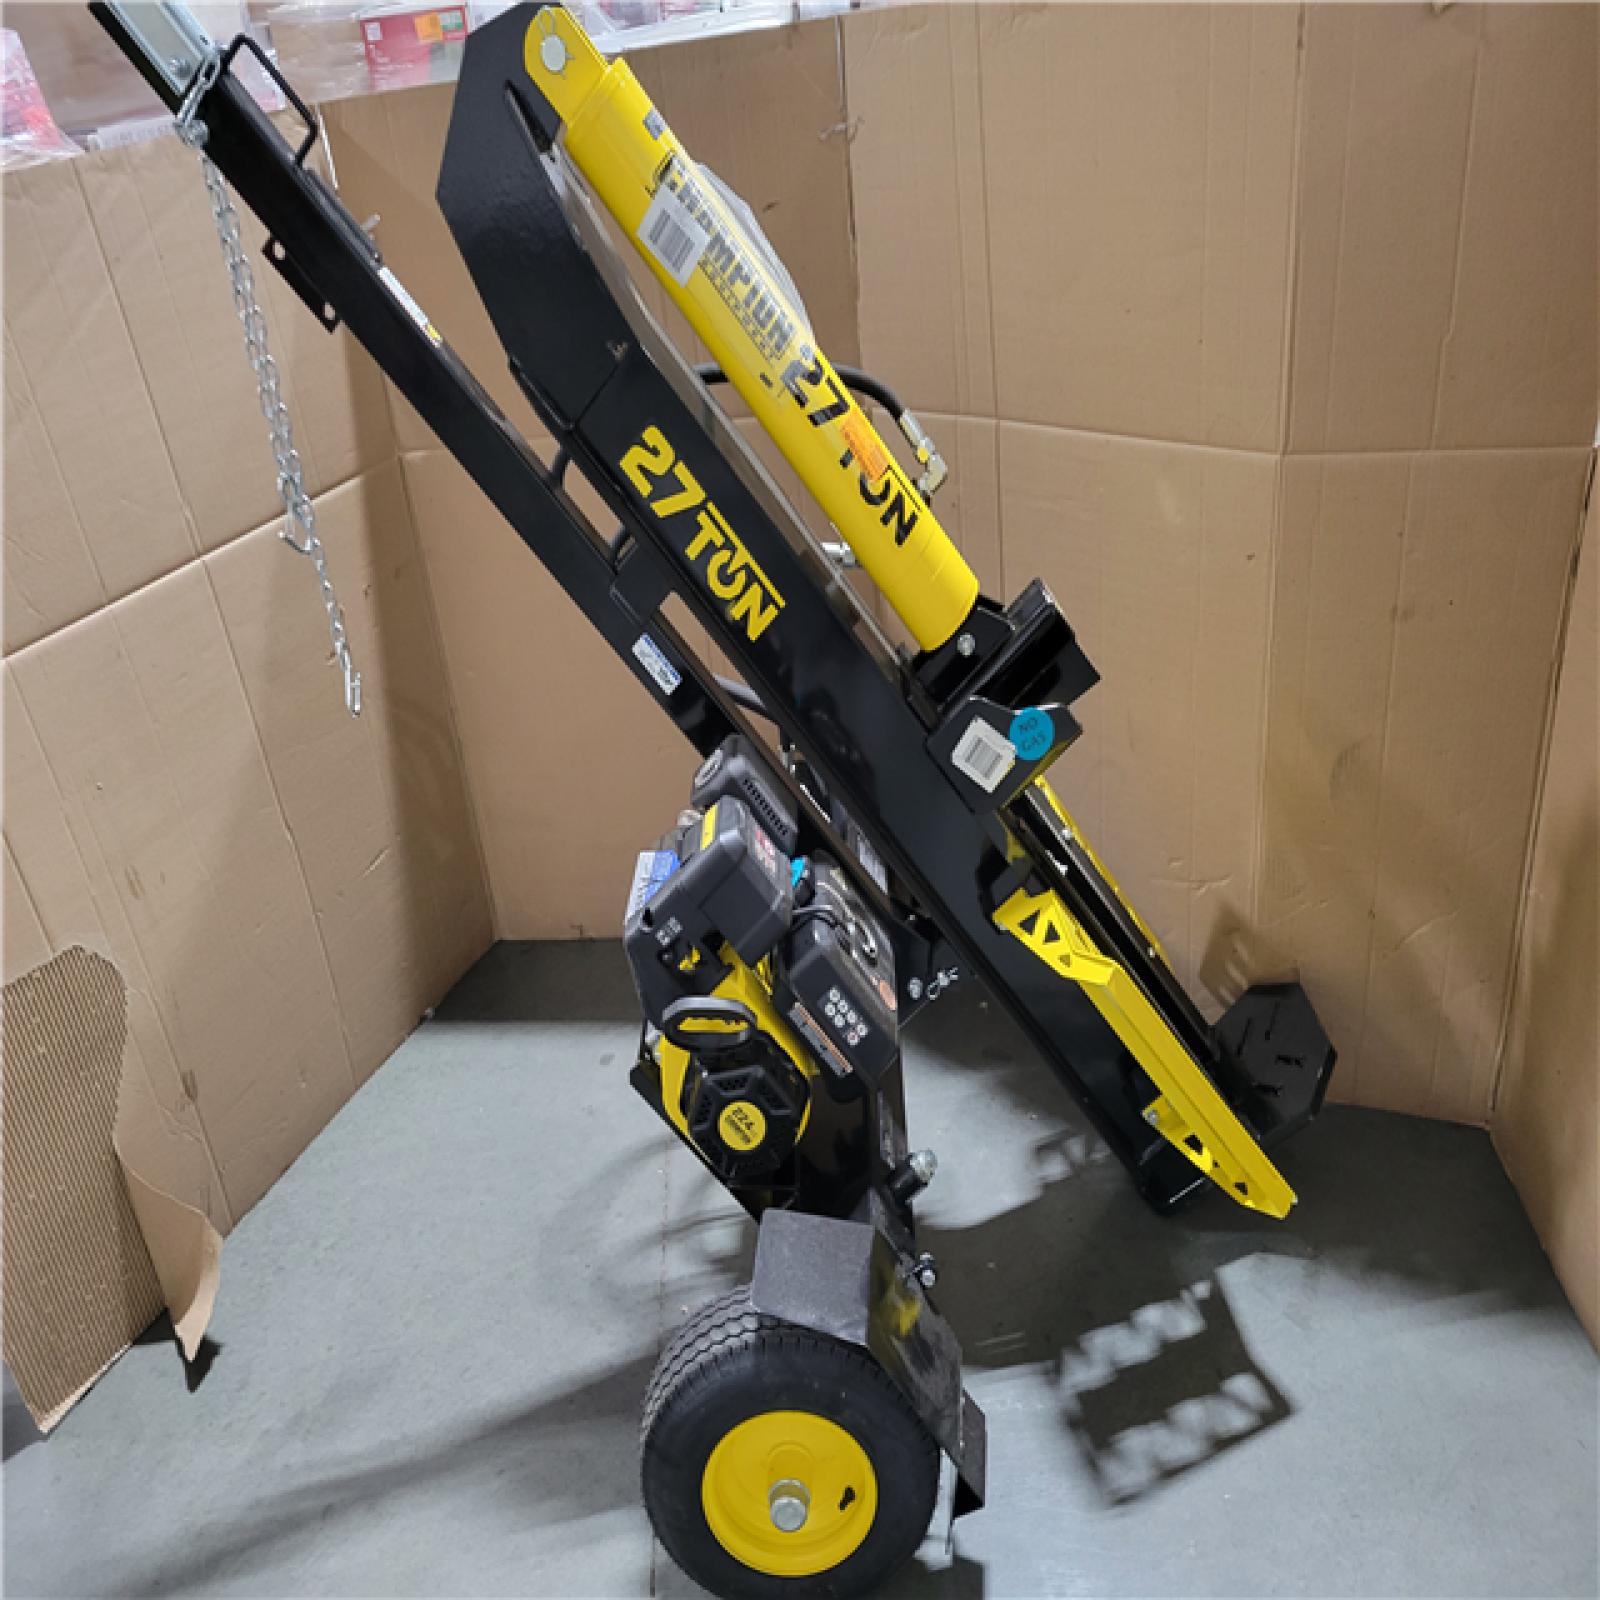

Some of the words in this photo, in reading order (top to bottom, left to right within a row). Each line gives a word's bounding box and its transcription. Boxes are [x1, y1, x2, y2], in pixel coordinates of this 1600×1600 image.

[780, 356, 850, 427] 27
[619, 425, 706, 518] 27
[685, 503, 785, 641] TON
[1018, 716, 1038, 732] NO
